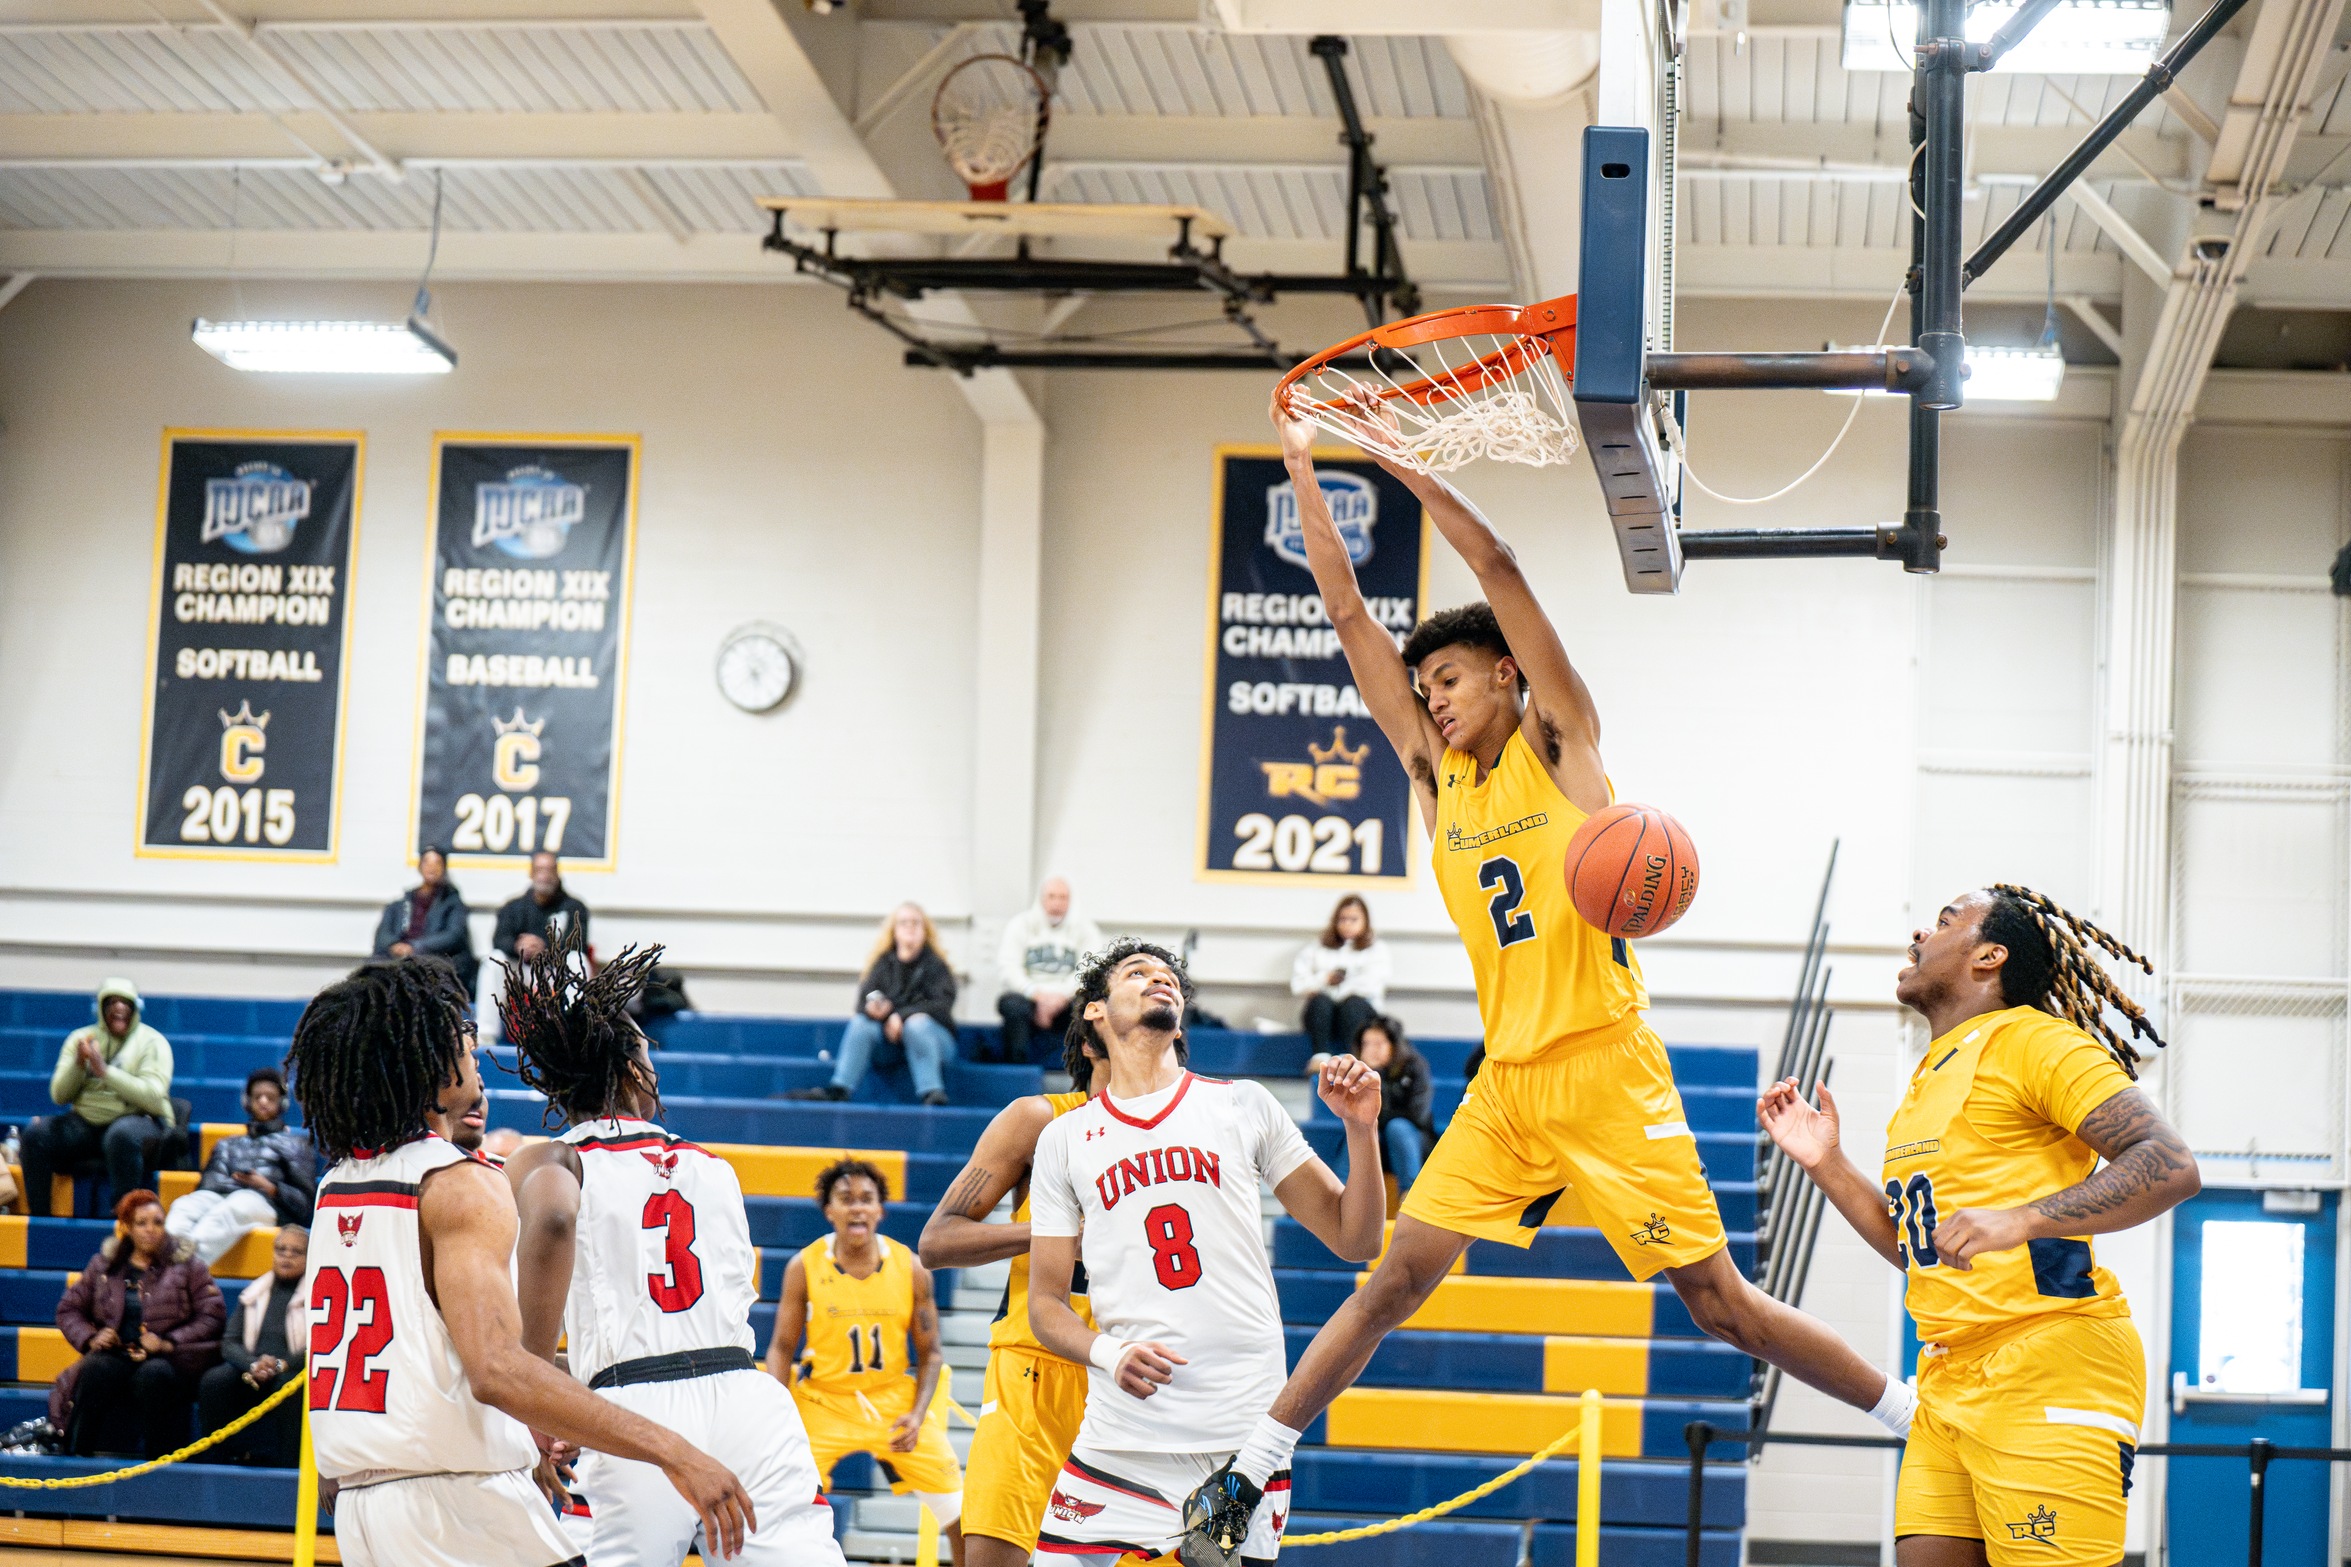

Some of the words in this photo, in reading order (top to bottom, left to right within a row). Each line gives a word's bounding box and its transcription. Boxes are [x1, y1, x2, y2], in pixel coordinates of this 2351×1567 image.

[173, 563, 283, 593] REGION
[287, 565, 335, 595] XIX
[443, 568, 557, 598] REGION
[562, 570, 610, 599] XIX
[174, 594, 330, 625] CHAMPION
[445, 599, 605, 630] CHAMPION
[1221, 592, 1329, 625] REGIO
[175, 648, 323, 682] SOFTBALL
[446, 654, 598, 688] BASEBALL
[1228, 681, 1372, 717] SOFTBA
[219, 724, 266, 783] C
[492, 731, 541, 791] C
[1260, 762, 1362, 807] RC
[180, 785, 295, 845] 2015
[452, 793, 571, 852] 2017
[1448, 813, 1548, 851] CUMERLAND
[1233, 813, 1384, 874] 2021
[1478, 854, 1537, 950] 2
[1620, 853, 1667, 935] SPALDING
[1095, 1145, 1221, 1211] UNION
[1144, 1203, 1202, 1291] 8
[1884, 1170, 1941, 1272] 20
[642, 1188, 704, 1313] 3
[309, 1266, 394, 1414] 22
[847, 1323, 884, 1374] 11
[2006, 1520, 2059, 1548] RC
